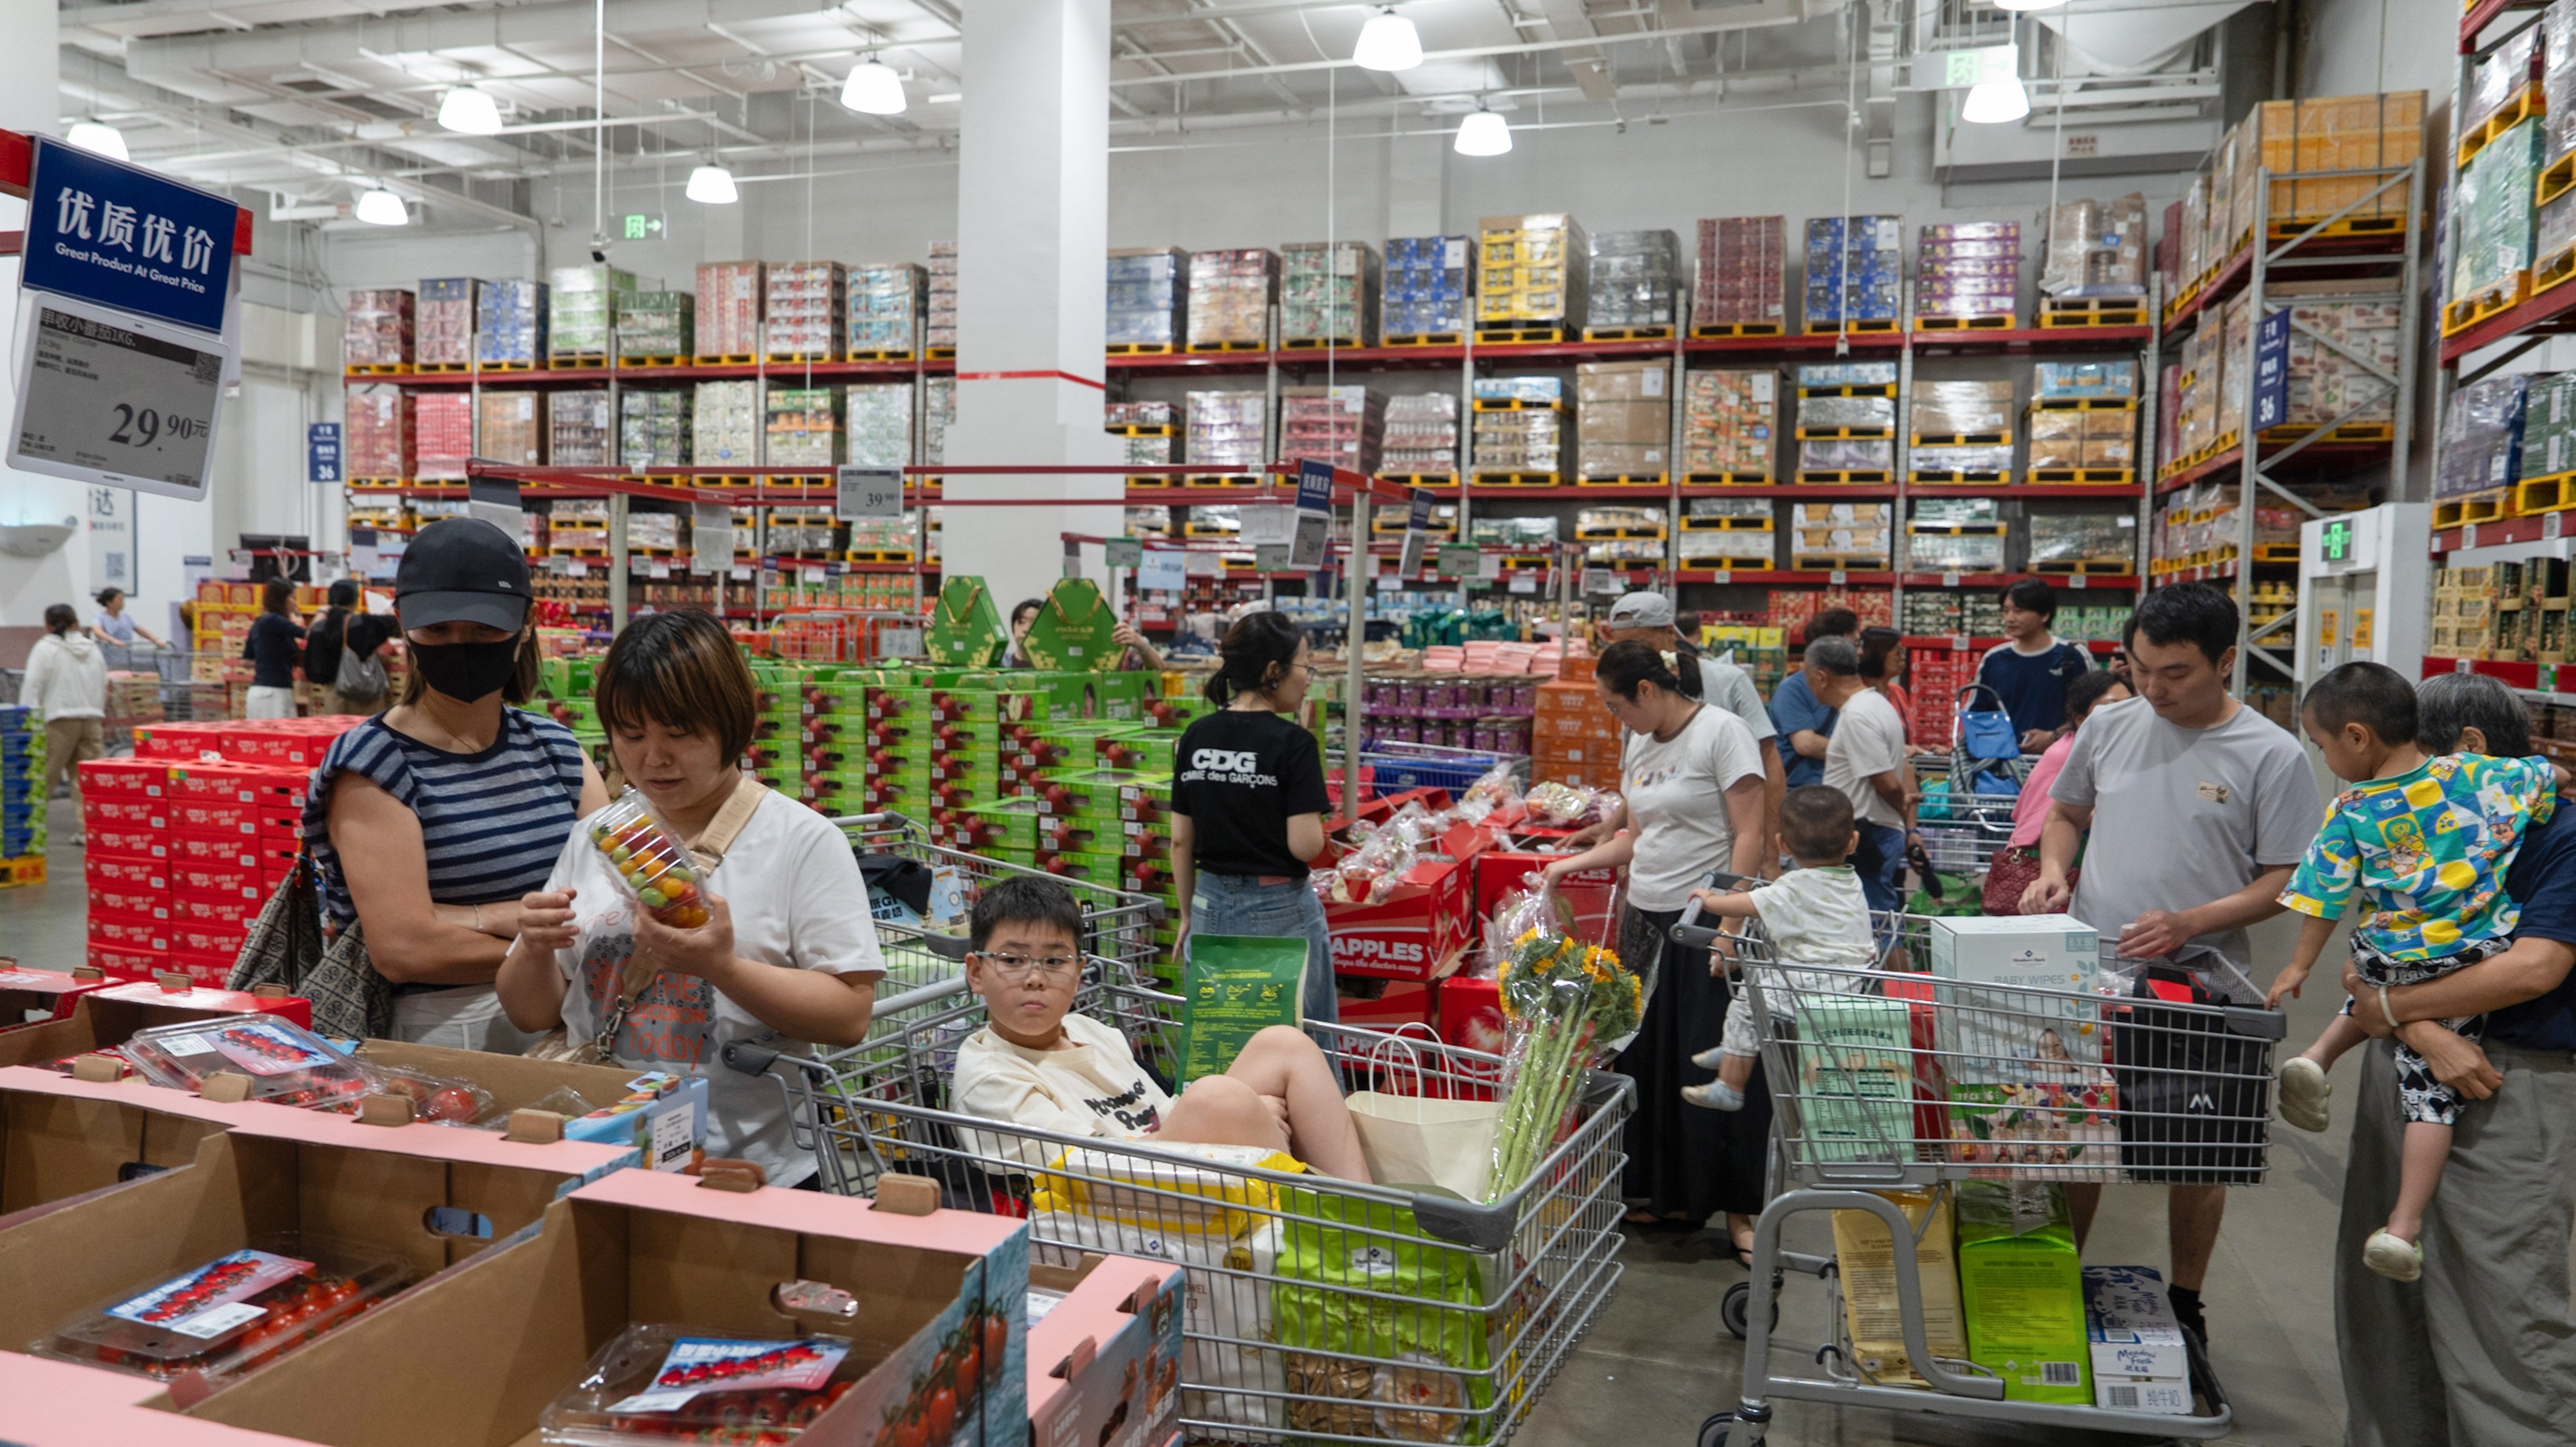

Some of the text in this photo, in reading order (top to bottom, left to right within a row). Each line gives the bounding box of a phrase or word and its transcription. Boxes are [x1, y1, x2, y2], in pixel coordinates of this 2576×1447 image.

[57, 186, 215, 275] 优质优价
[55, 241, 205, 294] Great Product At Great Price
[2260, 394, 2275, 423] 36
[318, 464, 335, 480] 36
[1191, 748, 1258, 773] CDG
[1207, 771, 1227, 782] des
[1229, 772, 1278, 789] GARÇONS
[1330, 936, 1424, 962] APPLES
[1355, 958, 1368, 968] the
[1369, 959, 1398, 970] doctor
[652, 972, 700, 1002] THE
[1994, 975, 2065, 985] BABY WIPES
[625, 1021, 706, 1071] Today
[1339, 1035, 1420, 1060] PPLES
[2117, 1348, 2157, 1361] Meadow
[2131, 1357, 2155, 1365] Fresh
[2146, 1388, 2182, 1407] 纯牛奶
